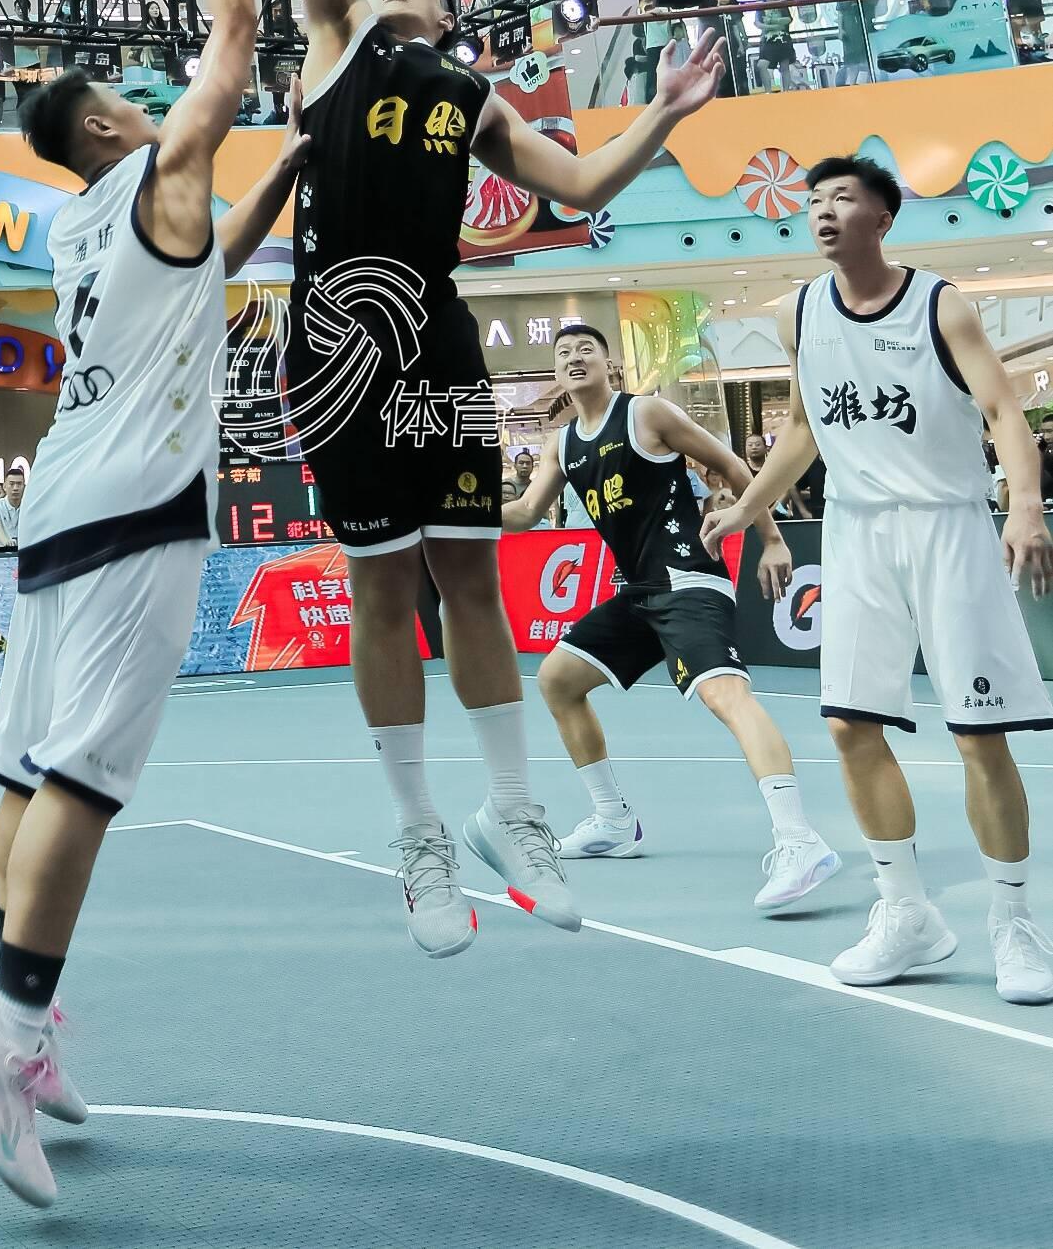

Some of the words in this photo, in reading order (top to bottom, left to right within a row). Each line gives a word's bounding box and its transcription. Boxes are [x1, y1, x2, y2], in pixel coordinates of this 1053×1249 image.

[820, 380, 917, 435] 潍坊
[231, 502, 274, 540] 12
[342, 517, 390, 531] KELME
